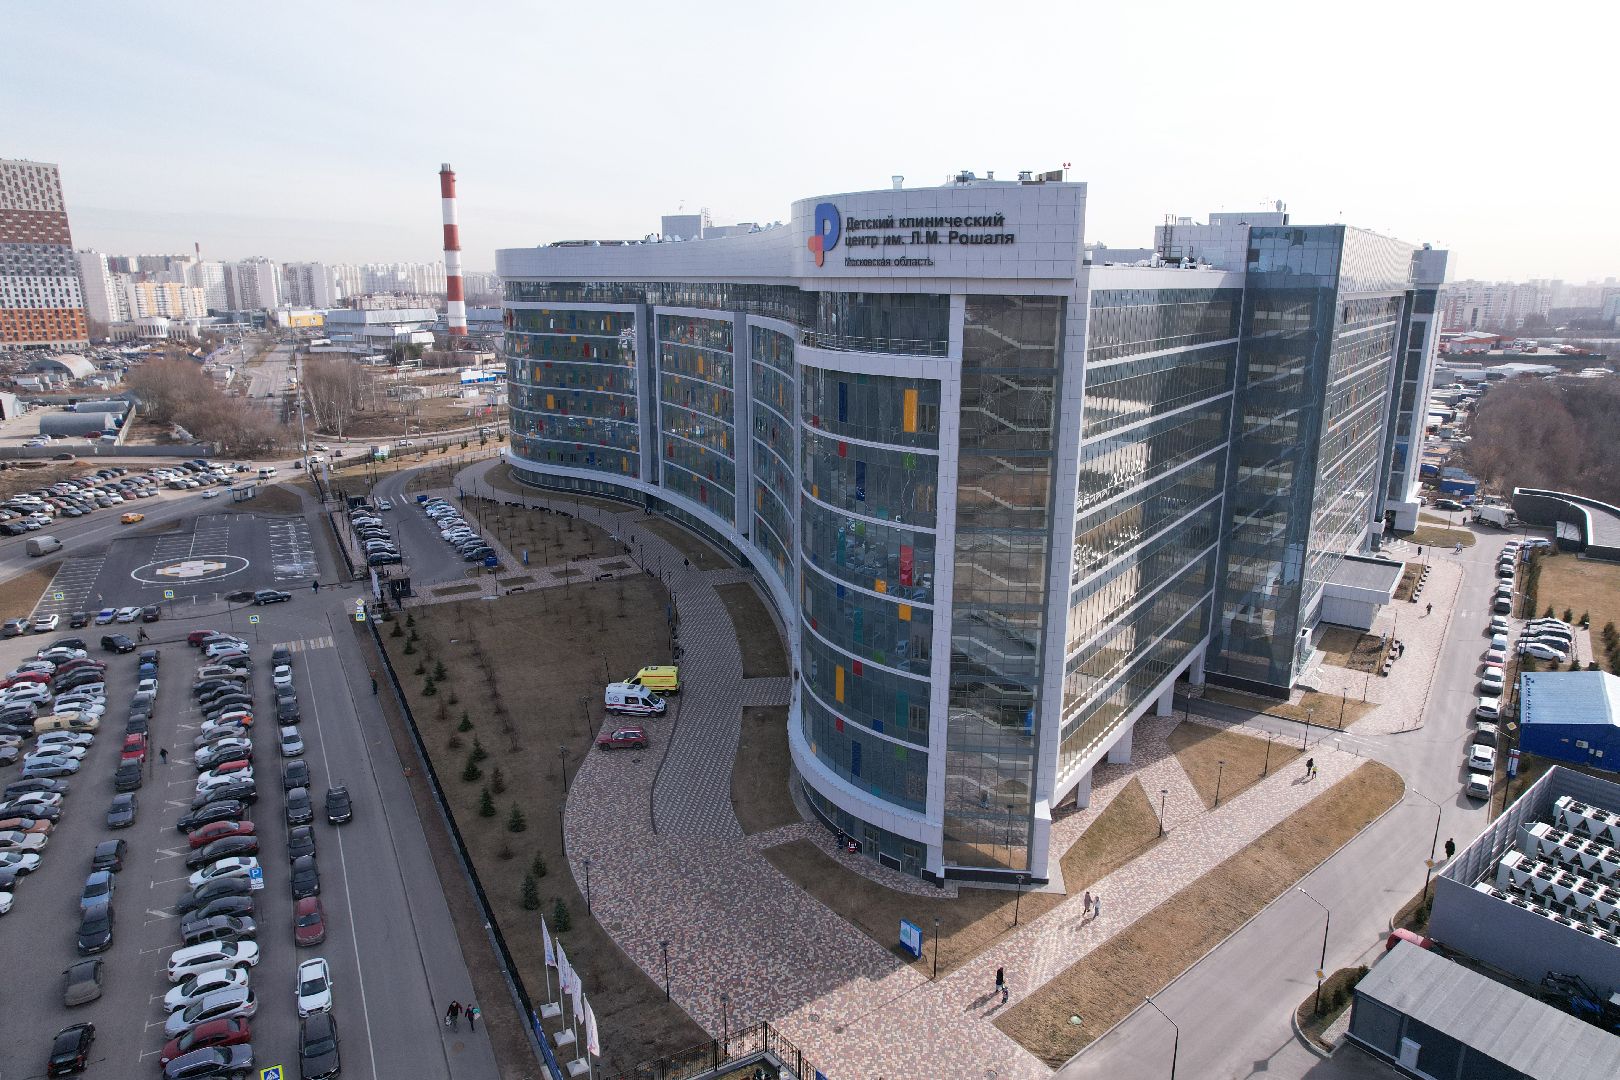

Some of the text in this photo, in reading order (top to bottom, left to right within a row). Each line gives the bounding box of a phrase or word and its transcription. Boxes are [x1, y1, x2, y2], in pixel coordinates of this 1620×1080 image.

[845, 212, 1004, 232] Детский клинический
[845, 230, 1015, 248] центр им. Л.М. Рошаля
[845, 255, 934, 267] Московская область
